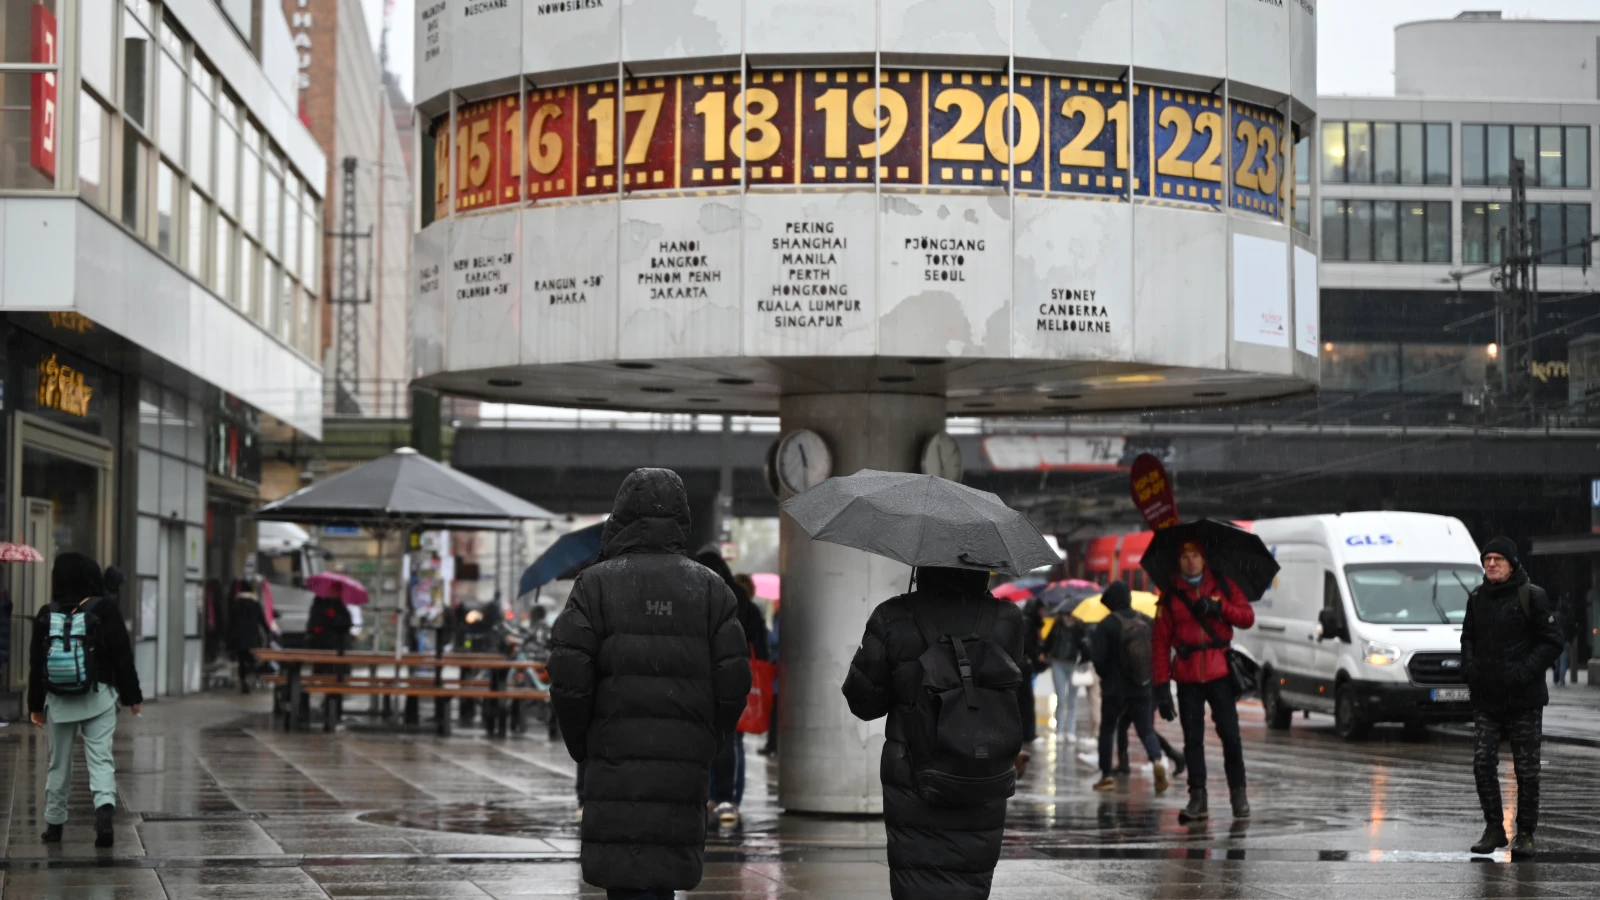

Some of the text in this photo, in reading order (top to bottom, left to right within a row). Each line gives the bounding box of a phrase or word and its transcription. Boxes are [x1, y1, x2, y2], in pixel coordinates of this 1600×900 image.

[537, 0, 604, 16] NOWOSIBIRSK
[456, 118, 491, 191] 15
[505, 103, 563, 178] 16
[587, 92, 665, 167] 17
[694, 87, 781, 161] 18
[815, 87, 909, 159] 19
[931, 87, 1041, 165] 20
[1059, 95, 1129, 170] 21
[1157, 105, 1223, 182] 22
[1235, 120, 1277, 195] 23
[785, 221, 835, 234] PEKING
[659, 240, 700, 253] HANOI
[772, 237, 847, 250] SHANGHAI
[904, 235, 985, 251] PJÖNGJANG
[650, 255, 708, 269] BANGKOK
[782, 253, 837, 265] MANILA
[925, 253, 965, 266] TOKYO
[637, 270, 722, 285] PHNOM PENH
[788, 268, 830, 280] PERTH
[924, 269, 965, 282] SEOUL
[534, 277, 577, 292] RANGUN
[772, 284, 848, 296] HONGKONG
[456, 286, 490, 300] COLOMBO
[550, 291, 587, 305] DHAKA
[649, 286, 709, 300] JAKARTA
[1050, 288, 1097, 301] SYDNEY
[757, 299, 862, 312] KUALA LUMPUR
[1039, 303, 1108, 317] CANBERRA
[774, 315, 843, 327] SINGAPUR
[1036, 319, 1111, 333] MELBOURNE
[646, 600, 673, 616] HH
